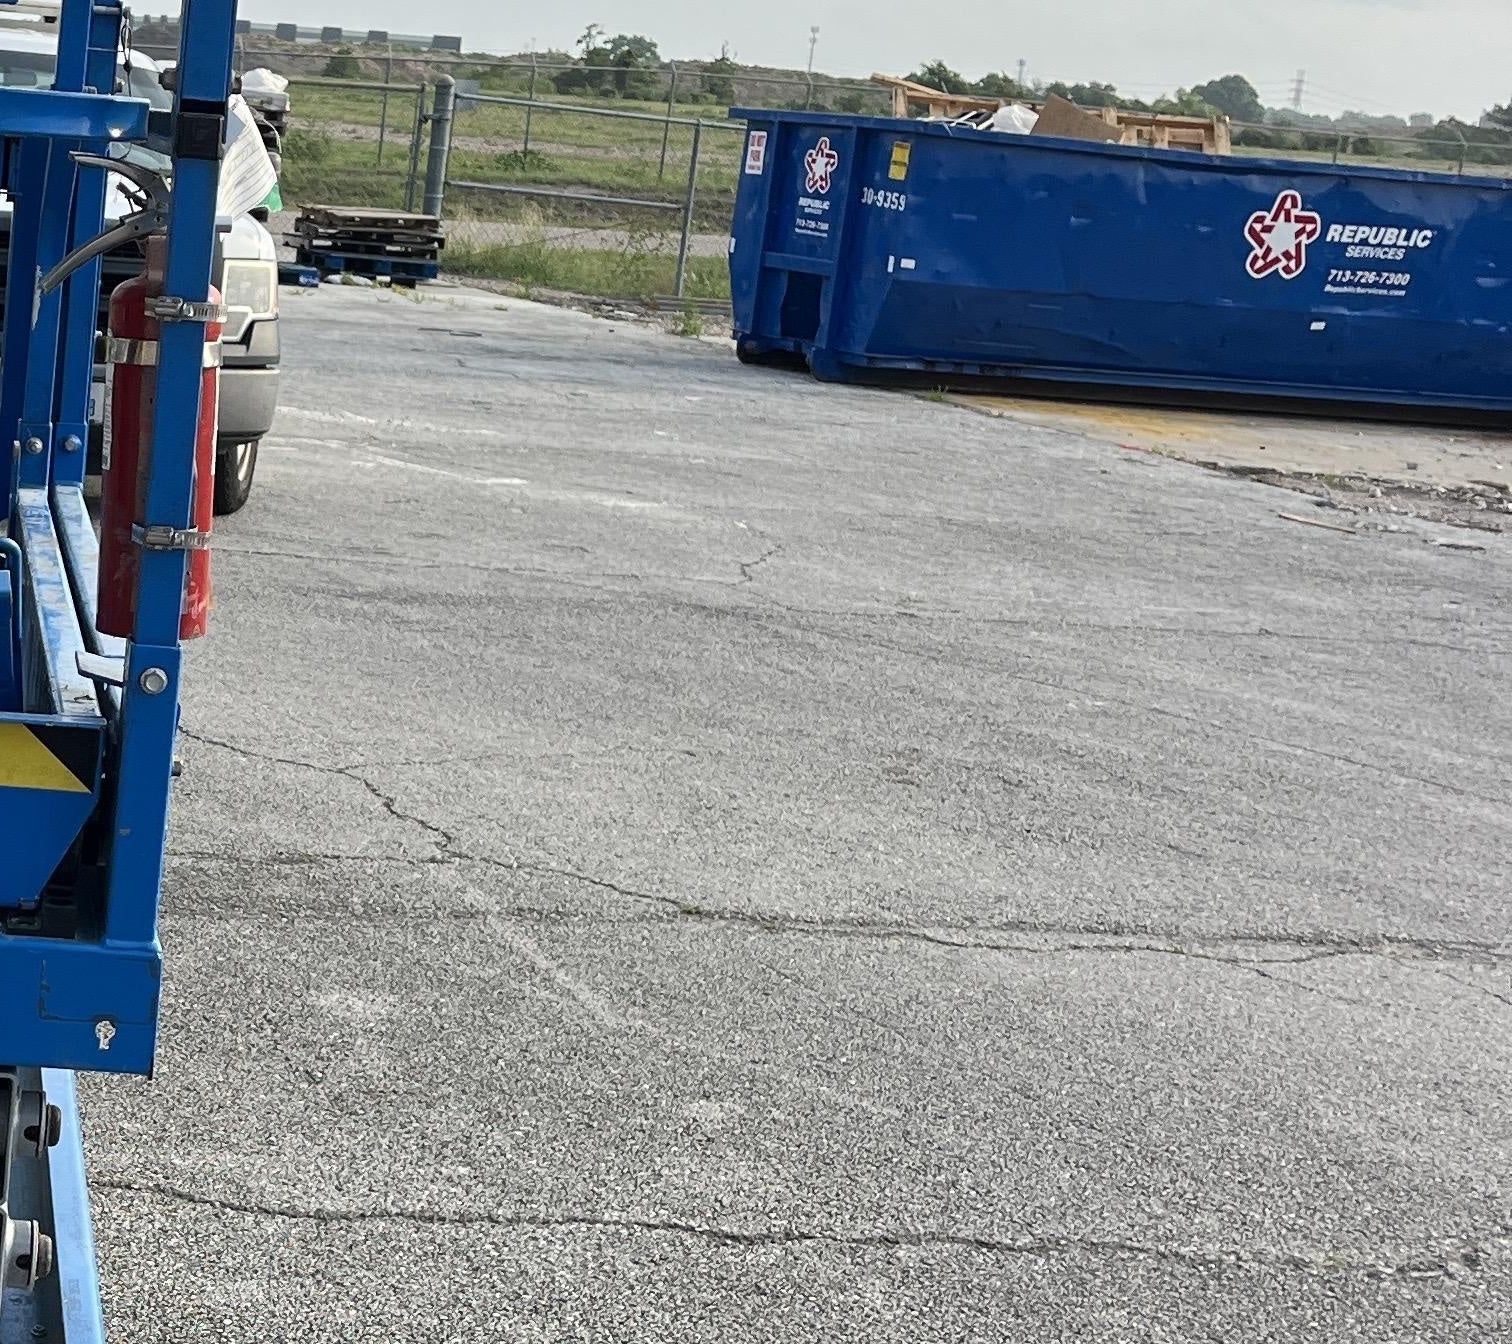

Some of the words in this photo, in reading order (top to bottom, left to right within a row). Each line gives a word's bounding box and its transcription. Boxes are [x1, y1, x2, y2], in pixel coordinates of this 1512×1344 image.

[1326, 223, 1433, 248] REPUBLIC
[1345, 245, 1406, 261] SERVICES
[1328, 269, 1411, 286] 713-726-7300
